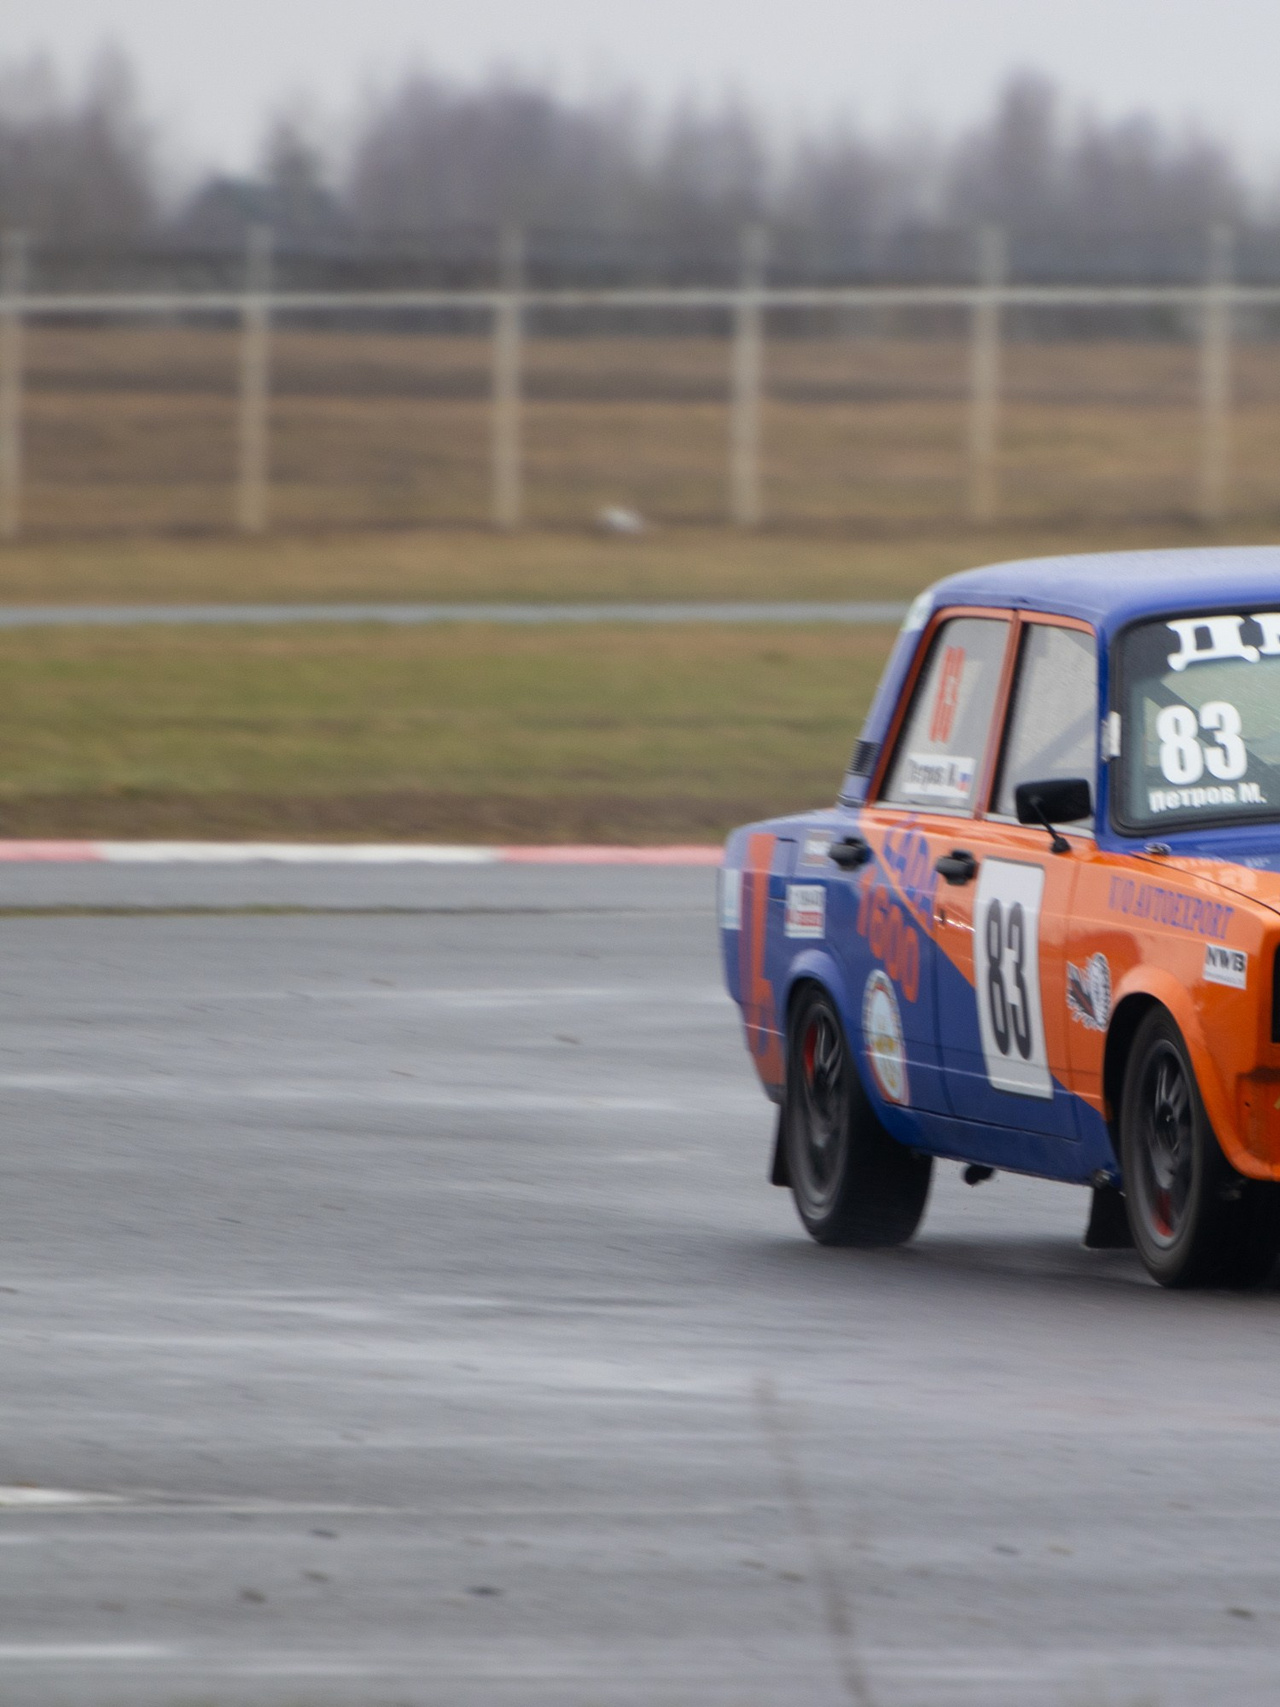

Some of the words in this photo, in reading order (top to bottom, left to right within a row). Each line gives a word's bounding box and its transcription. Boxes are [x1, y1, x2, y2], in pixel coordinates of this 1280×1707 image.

[1156, 701, 1247, 785] 83
[986, 897, 1031, 1061] 83
[1205, 942, 1246, 974] NWB
